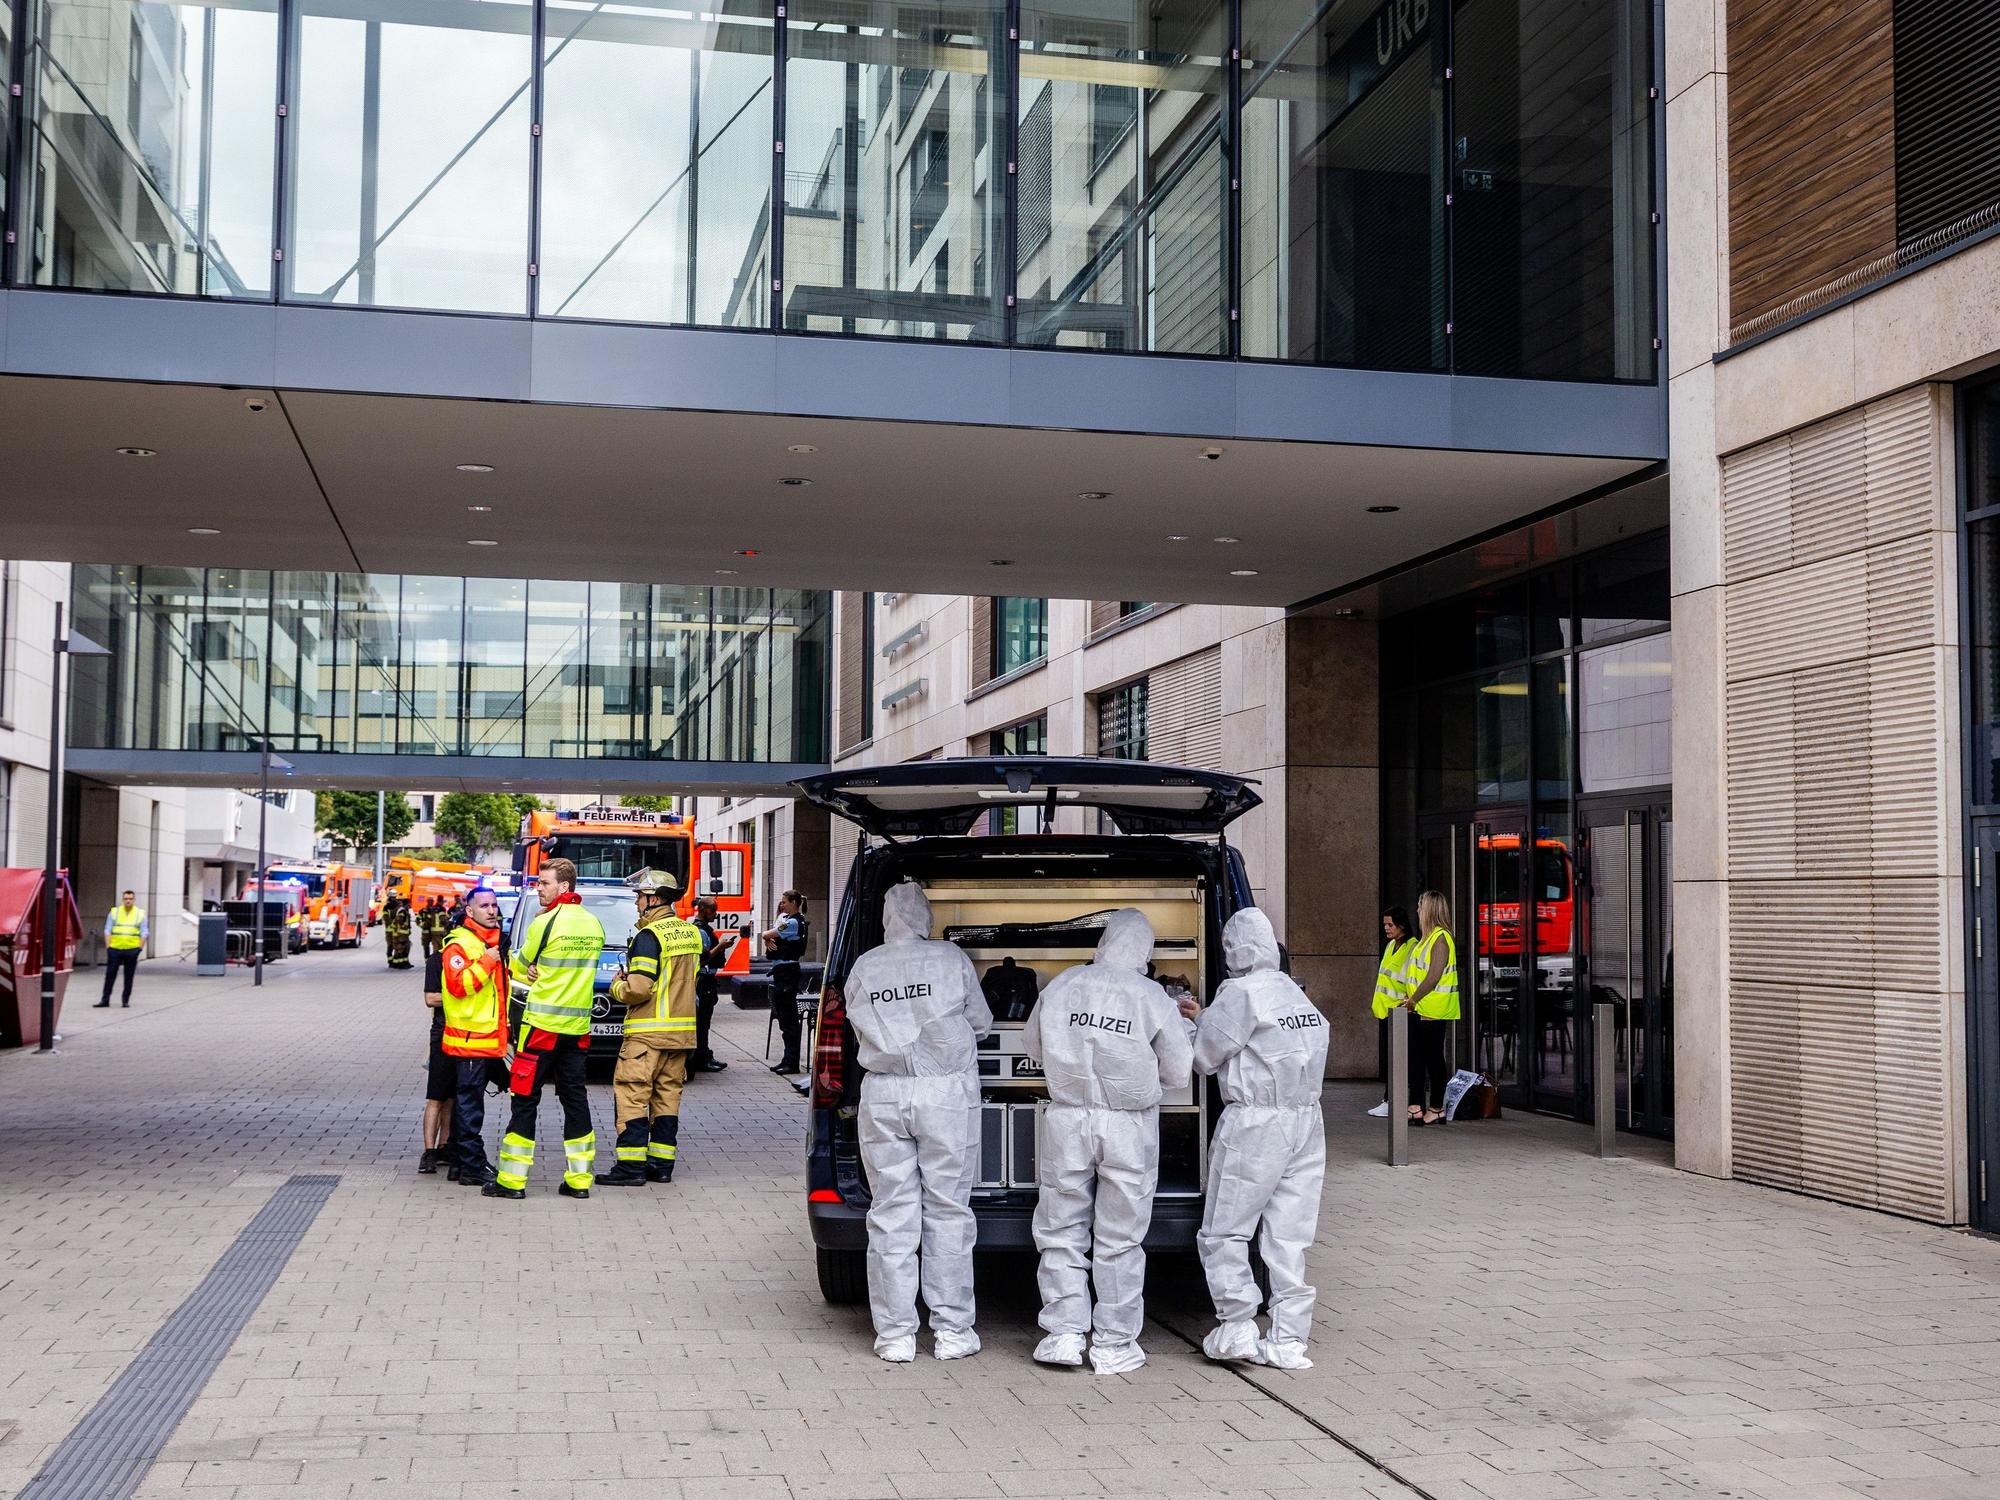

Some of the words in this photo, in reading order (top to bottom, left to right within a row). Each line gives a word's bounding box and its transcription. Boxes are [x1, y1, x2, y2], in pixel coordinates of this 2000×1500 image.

[584, 812, 655, 822] FEUERWEHR
[715, 913, 739, 929] 112
[870, 983, 931, 1005] POLIZEI
[593, 1025, 599, 1034] 4
[1069, 1012, 1132, 1035] POLIZEI
[1277, 1013, 1322, 1031] POIZEI
